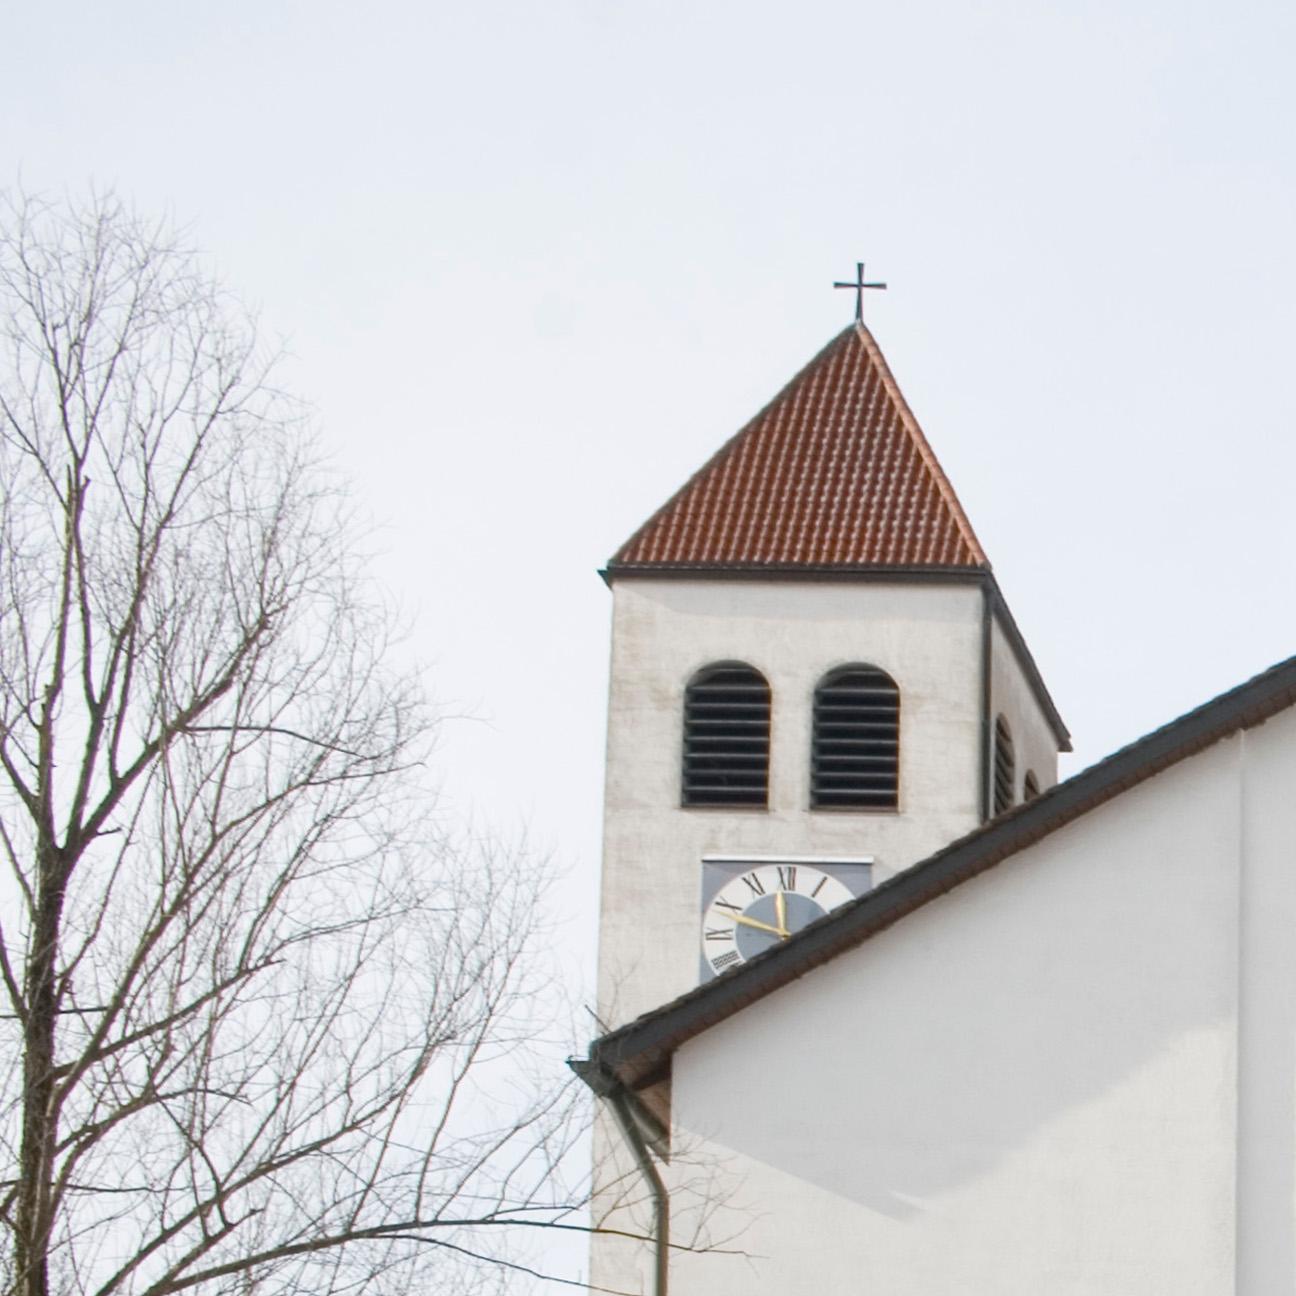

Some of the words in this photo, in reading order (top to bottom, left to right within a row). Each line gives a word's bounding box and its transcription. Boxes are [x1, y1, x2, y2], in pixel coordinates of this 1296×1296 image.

[742, 872, 766, 896] XI
[777, 866, 796, 891] XII
[811, 876, 828, 898] I
[715, 896, 743, 914] X
[705, 927, 733, 941] IX
